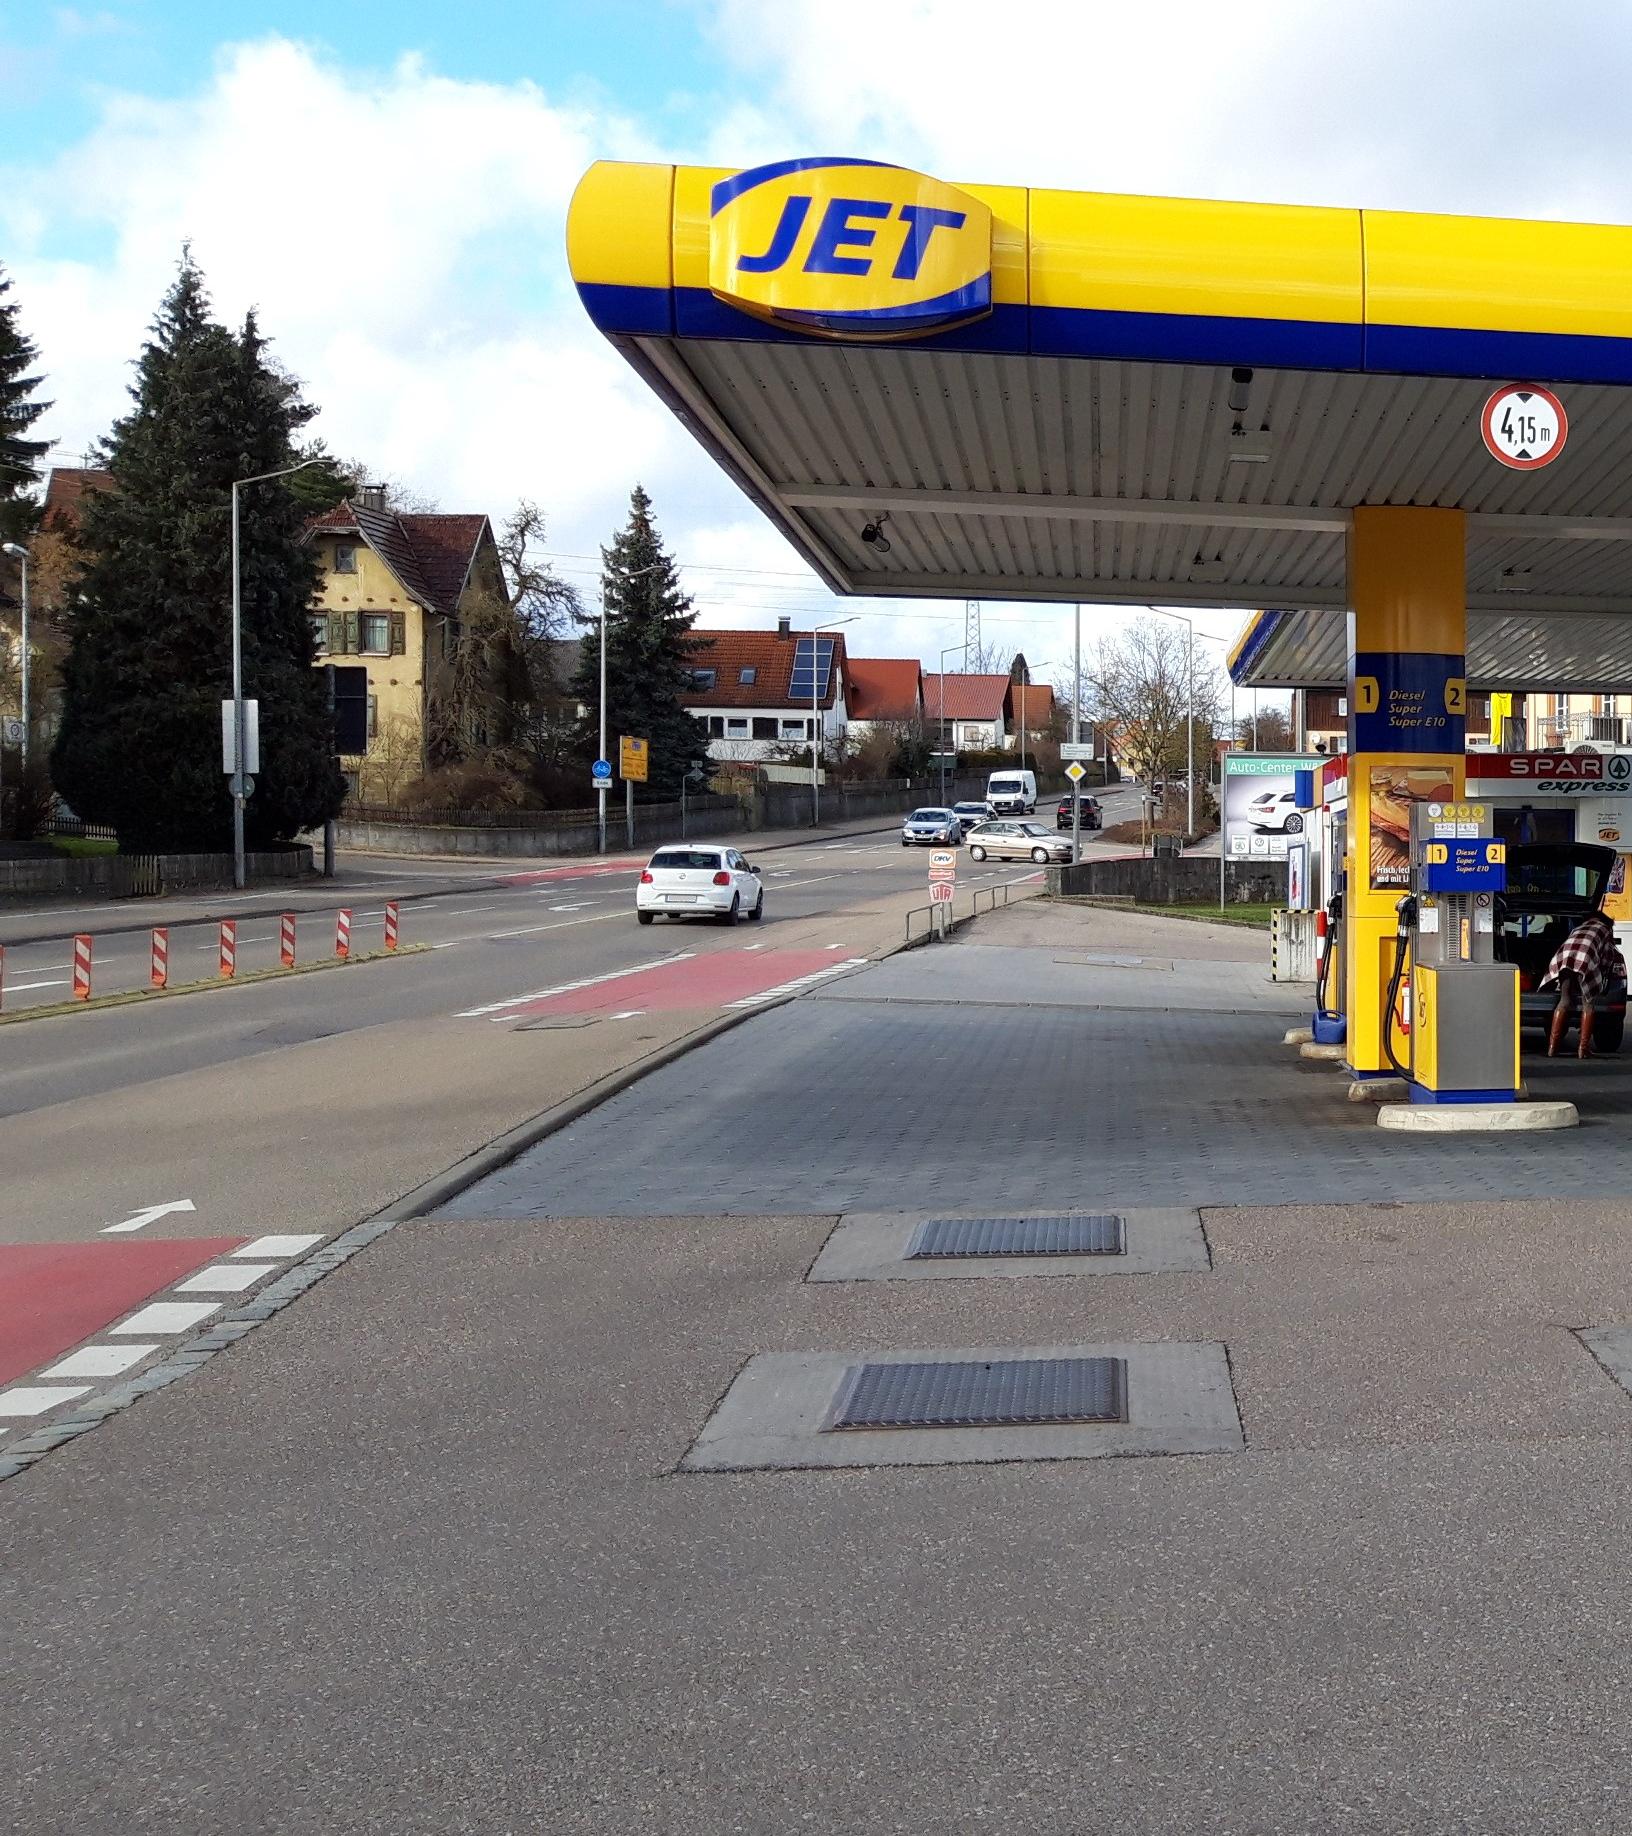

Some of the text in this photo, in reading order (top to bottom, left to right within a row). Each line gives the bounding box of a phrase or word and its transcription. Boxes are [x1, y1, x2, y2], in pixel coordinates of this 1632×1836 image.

[736, 196, 967, 280] JET
[1501, 407, 1551, 446] 4,15 m
[1362, 685, 1371, 704] 1
[1388, 689, 1426, 700] Diesel
[1449, 687, 1460, 706] 2
[1388, 703, 1423, 715] Super
[1388, 716, 1446, 728] Super E10
[1509, 758, 1601, 775] SPAR
[1537, 780, 1631, 794] express
[1436, 849, 1442, 860] 1
[1490, 848, 1499, 860] 2
[1455, 857, 1476, 865] Super
[1455, 865, 1476, 874] Super
